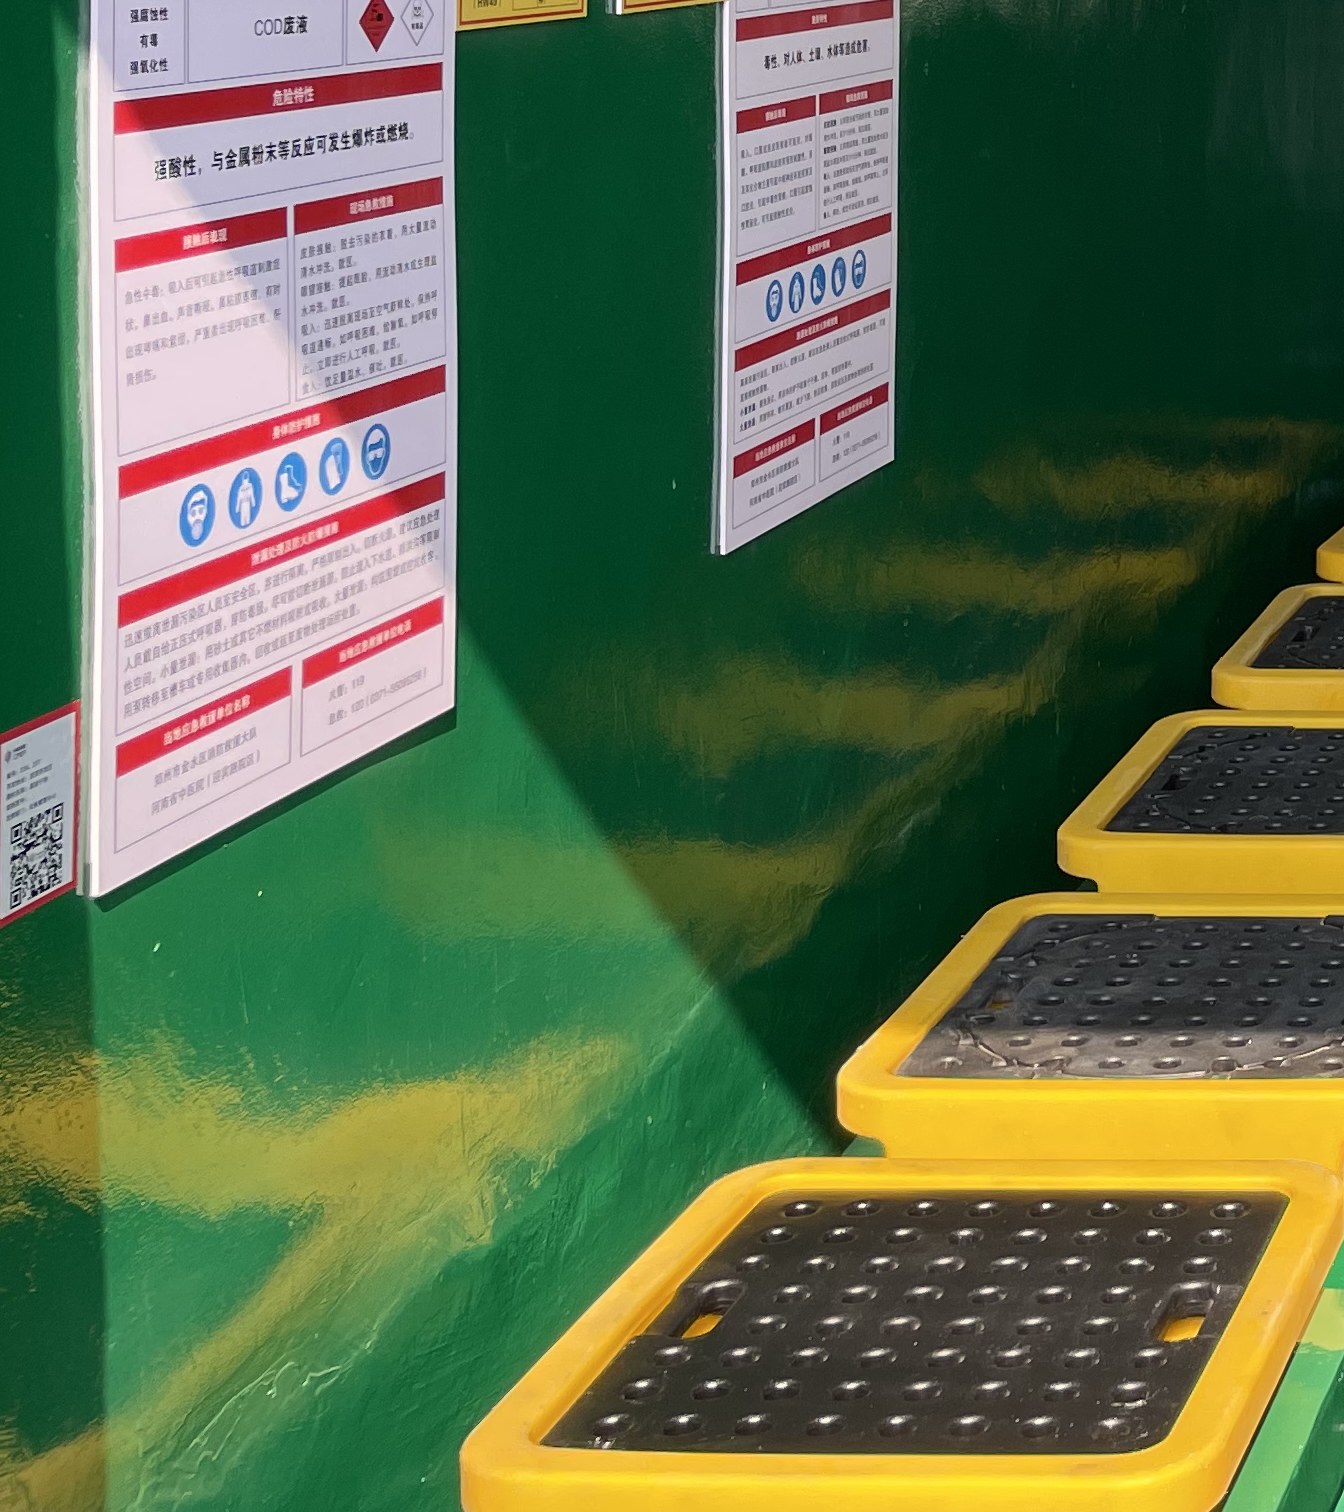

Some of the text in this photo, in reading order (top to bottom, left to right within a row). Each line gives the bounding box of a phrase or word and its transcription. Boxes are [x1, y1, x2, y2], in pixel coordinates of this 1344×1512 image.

[128, 5, 170, 25] 强腐蚀性
[253, 12, 308, 39] COD废液
[138, 31, 159, 50] 有毒
[128, 55, 169, 77] 强氧化性
[271, 83, 315, 109] 危险特性
